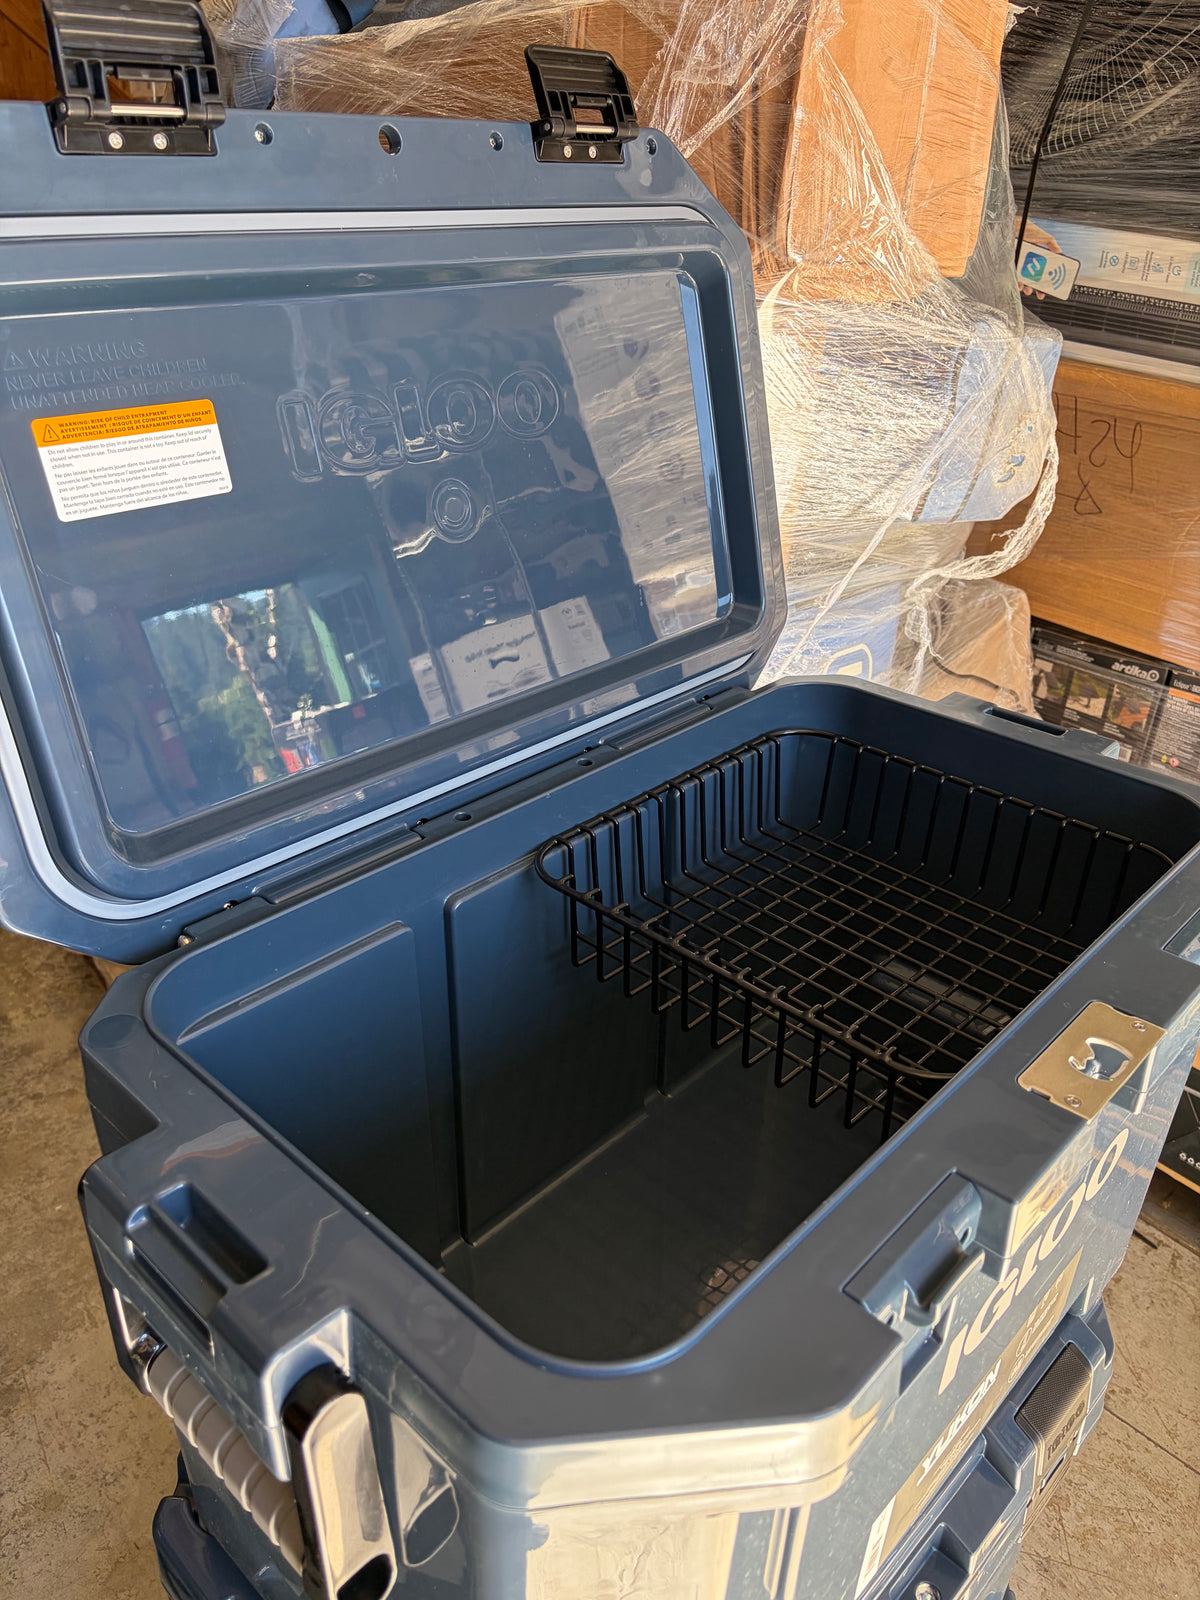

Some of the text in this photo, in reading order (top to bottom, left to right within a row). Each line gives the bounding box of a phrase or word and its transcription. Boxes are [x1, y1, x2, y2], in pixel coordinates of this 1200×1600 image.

[27, 341, 148, 368] WARNING
[4, 357, 208, 392] NEVER LEAVE CHILDREN
[9, 371, 247, 410] UNATTENDED NEAR COOLER.
[59, 420, 90, 428] WARNING:
[131, 410, 167, 419] ENTRAPMENT
[60, 424, 107, 434] AVERTISSEMENT
[142, 415, 177, 423] COINCEMENT
[62, 430, 105, 439] ADVERTENCIA:
[135, 421, 177, 430] ATRAPAMIENTO
[276, 366, 562, 482] IGLOO
[1111, 662, 1149, 681] artika
[938, 1128, 1130, 1396] IGLOO
[915, 1360, 1002, 1488] YUKON
[1047, 1400, 1086, 1461] IGLOO
